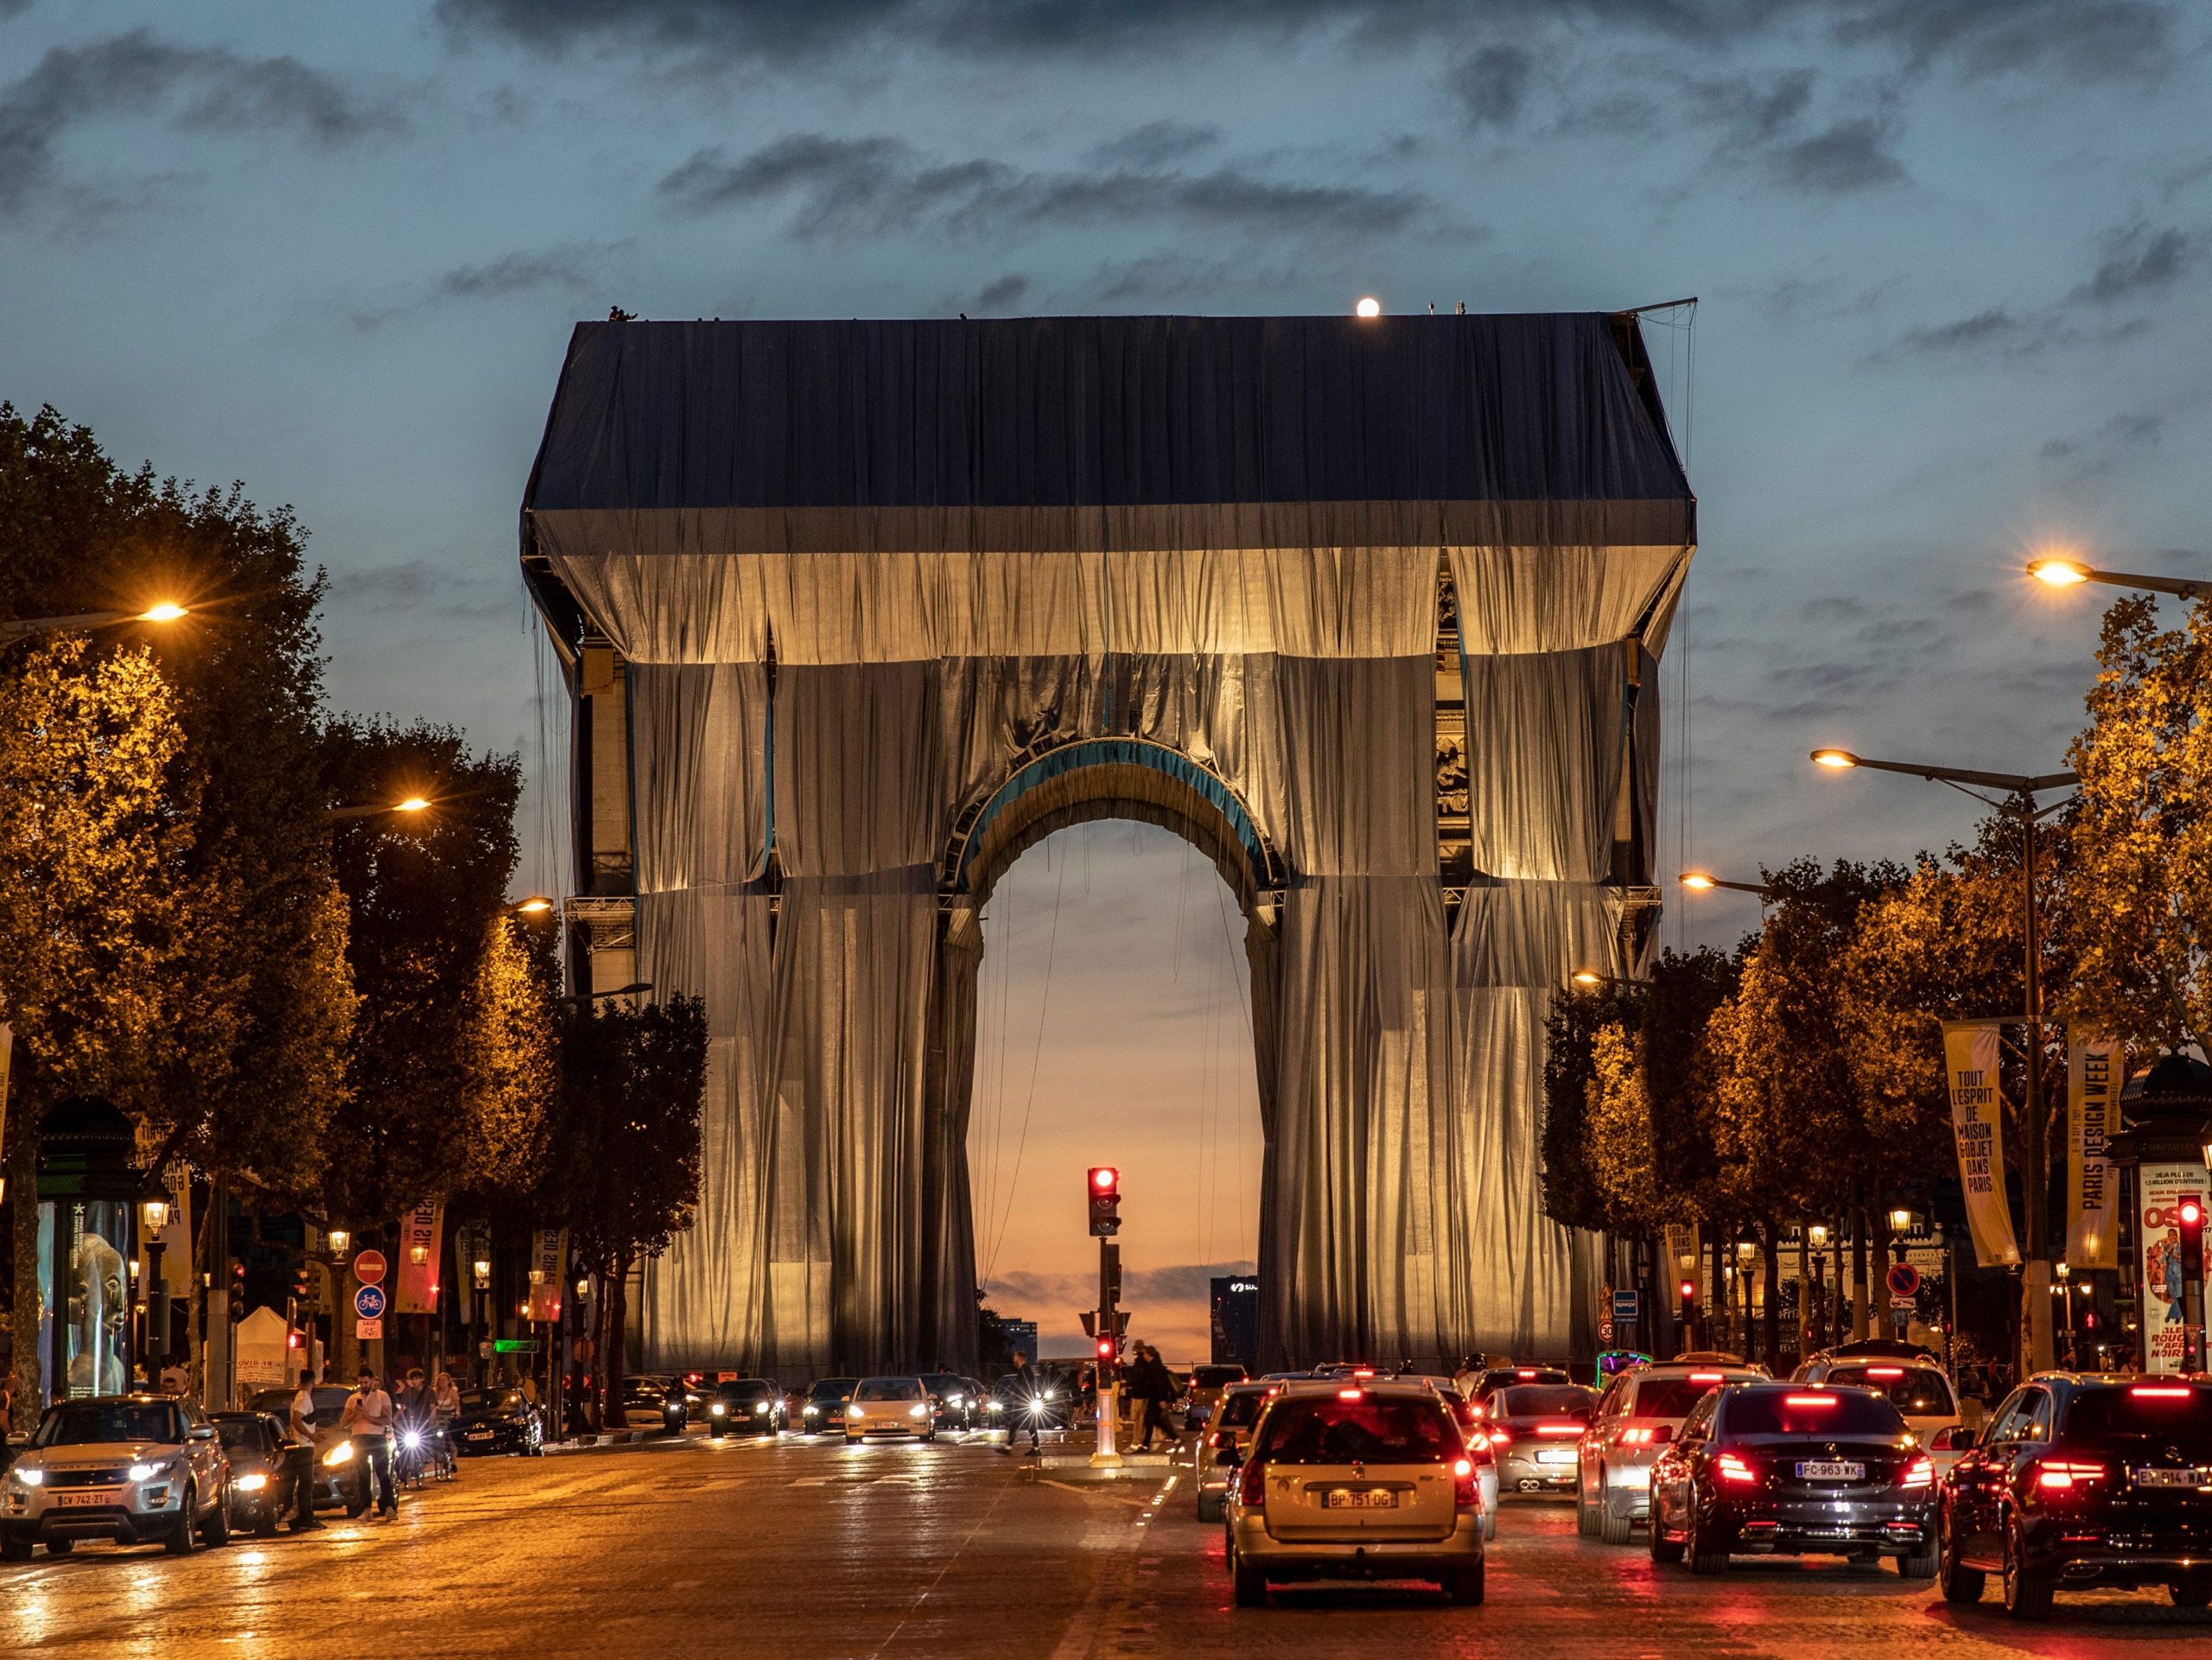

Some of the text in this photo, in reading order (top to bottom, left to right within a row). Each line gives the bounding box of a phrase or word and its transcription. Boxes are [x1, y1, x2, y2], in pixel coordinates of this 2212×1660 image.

[1957, 1071, 1984, 1086] TOUT
[1952, 1087, 1993, 1104] L'ESPRIT
[1966, 1106, 1978, 1122] DE
[1957, 1123, 1992, 1140] MAISON
[2082, 1053, 2109, 1210] PARIS DESIGN WEEK
[1960, 1140, 1993, 1157] &OBJET
[1967, 1159, 1989, 1175] DANS
[1968, 1176, 1993, 1193] PARIS
[1672, 1237, 1691, 1248] DANS
[1603, 1326, 1613, 1336] 30
[2152, 1333, 2185, 1342] ROUG
[1803, 1465, 1857, 1475] FC-963-WK
[1331, 1493, 1389, 1506] BP-751-DG
